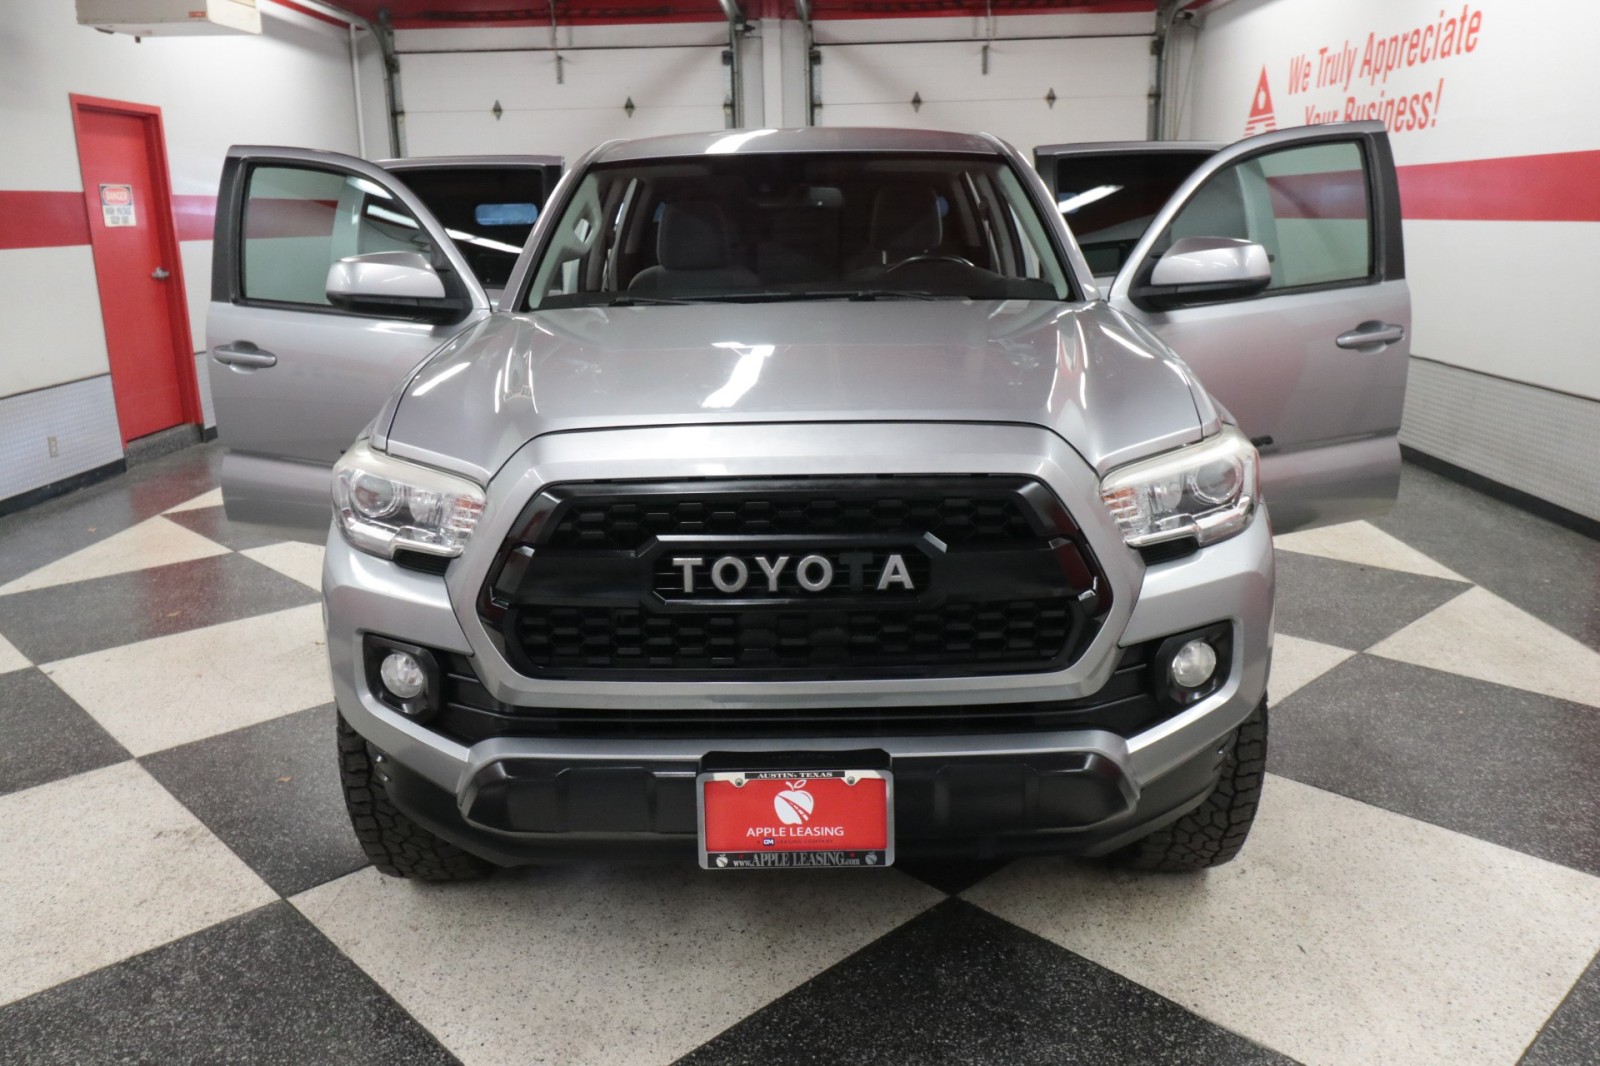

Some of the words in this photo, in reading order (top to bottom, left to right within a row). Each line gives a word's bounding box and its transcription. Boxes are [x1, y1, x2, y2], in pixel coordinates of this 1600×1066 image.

[1288, 54, 1311, 95] We
[1316, 40, 1358, 92] Truly
[1358, 4, 1482, 86] Appreciate
[672, 554, 915, 593] TOYOTA
[746, 827, 786, 837] APPLE
[789, 826, 844, 837] LEASING
